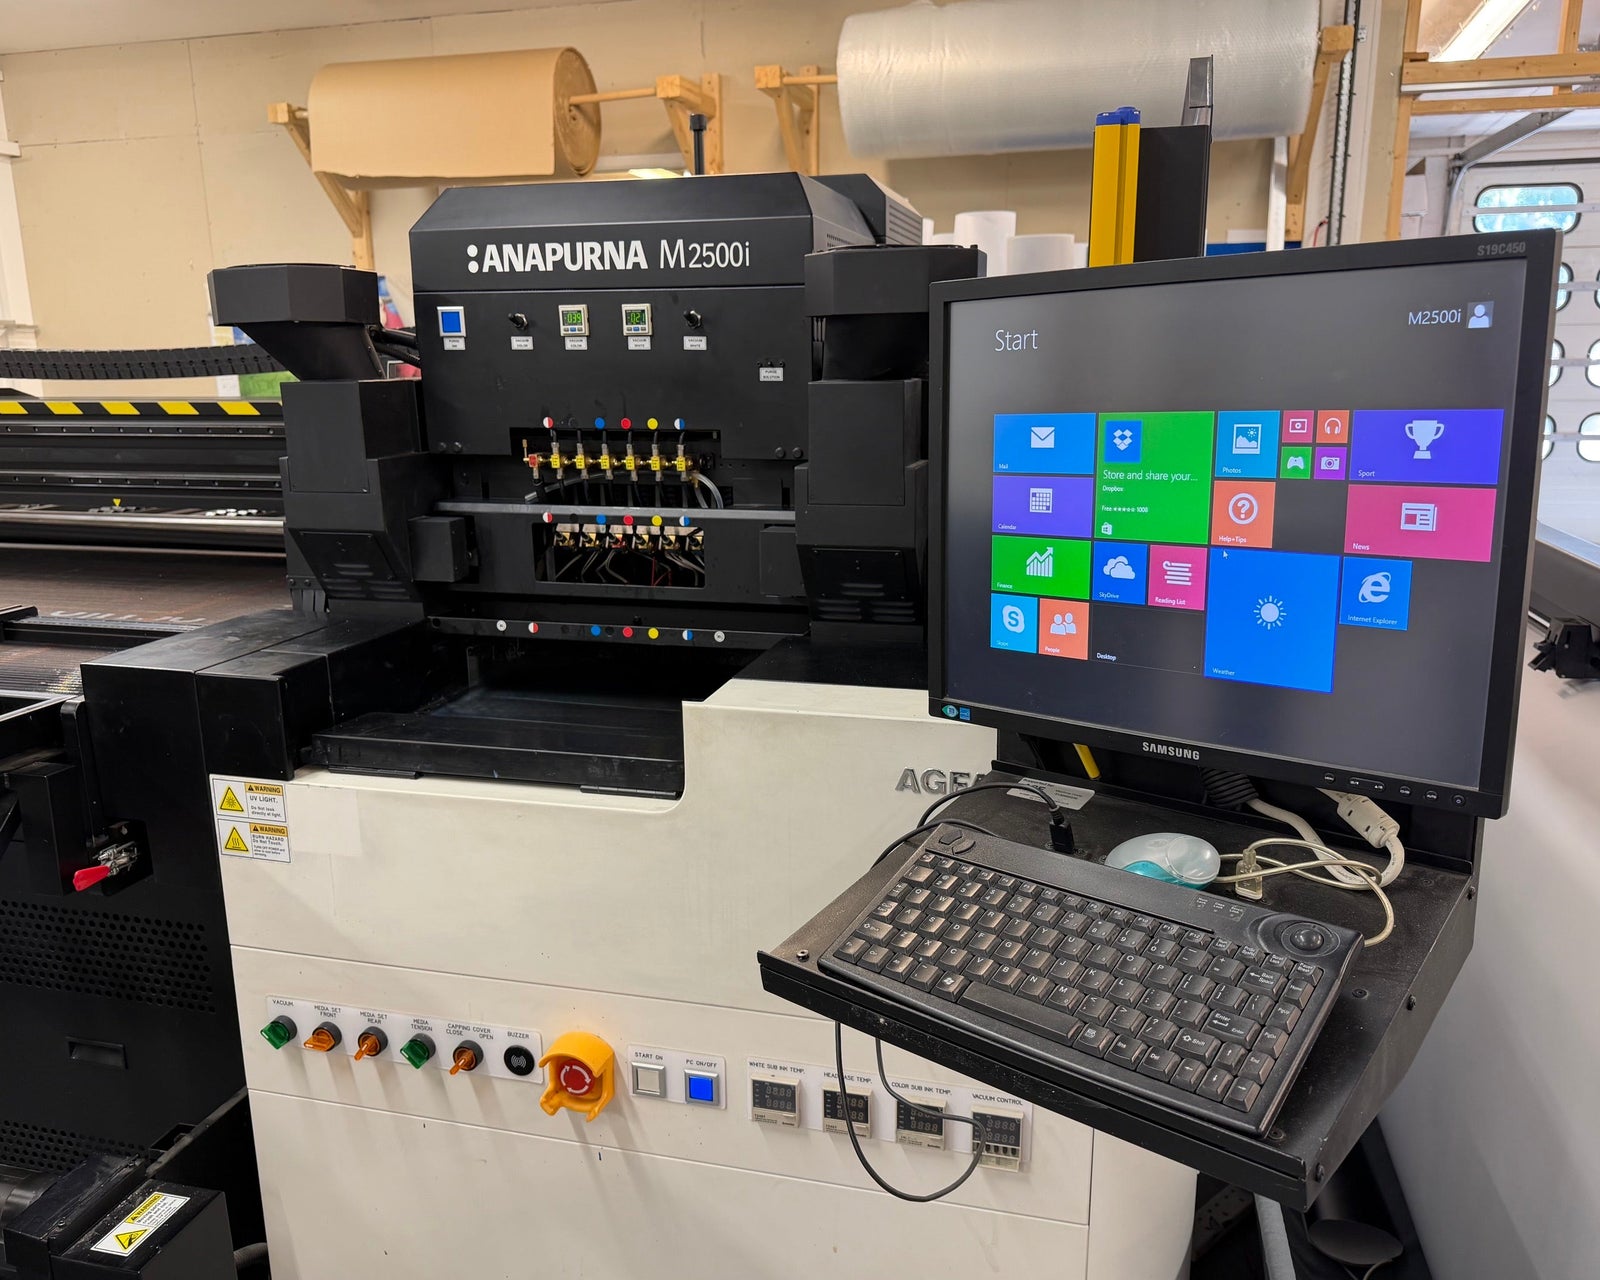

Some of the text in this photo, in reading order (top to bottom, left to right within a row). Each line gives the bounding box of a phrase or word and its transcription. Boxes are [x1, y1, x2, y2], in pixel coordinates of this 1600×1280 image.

[1477, 242, 1526, 256] S19C450
[659, 239, 750, 270] M2500i
[1408, 308, 1462, 325] M2500i
[995, 329, 1039, 351] Start
[1222, 466, 1242, 474] Photos
[1358, 470, 1376, 478] Sport
[1103, 469, 1199, 484] Store and share your...
[1102, 485, 1124, 493] Dropbox
[1218, 536, 1247, 544] Help+Tips
[1352, 543, 1370, 551] News
[996, 582, 1013, 590] Finance
[1098, 592, 1120, 600] SkyDrive
[1154, 596, 1186, 606] Reading List
[1347, 614, 1398, 626] Internet Explorer
[1044, 646, 1061, 654] People
[1096, 653, 1117, 662] Desktop
[1212, 667, 1236, 676] Weather
[1142, 741, 1200, 760] SAMSUNG
[254, 785, 280, 794] WARNING
[260, 826, 286, 835] WARNING
[331, 1006, 341, 1014] SET
[413, 1018, 429, 1026] MEDIA
[1215, 1013, 1231, 1022] Enter
[410, 1024, 432, 1032] TENSION
[446, 1028, 464, 1036] CLOSE
[447, 1023, 491, 1034] CAPPING COVER
[507, 1030, 530, 1039] BUZZER
[634, 1052, 653, 1060] START
[695, 1060, 718, 1068] ON/OFF
[891, 1081, 910, 1090] COLOR
[910, 1084, 923, 1092] SUB
[972, 1093, 1023, 1106] VACUUM CONTROL
